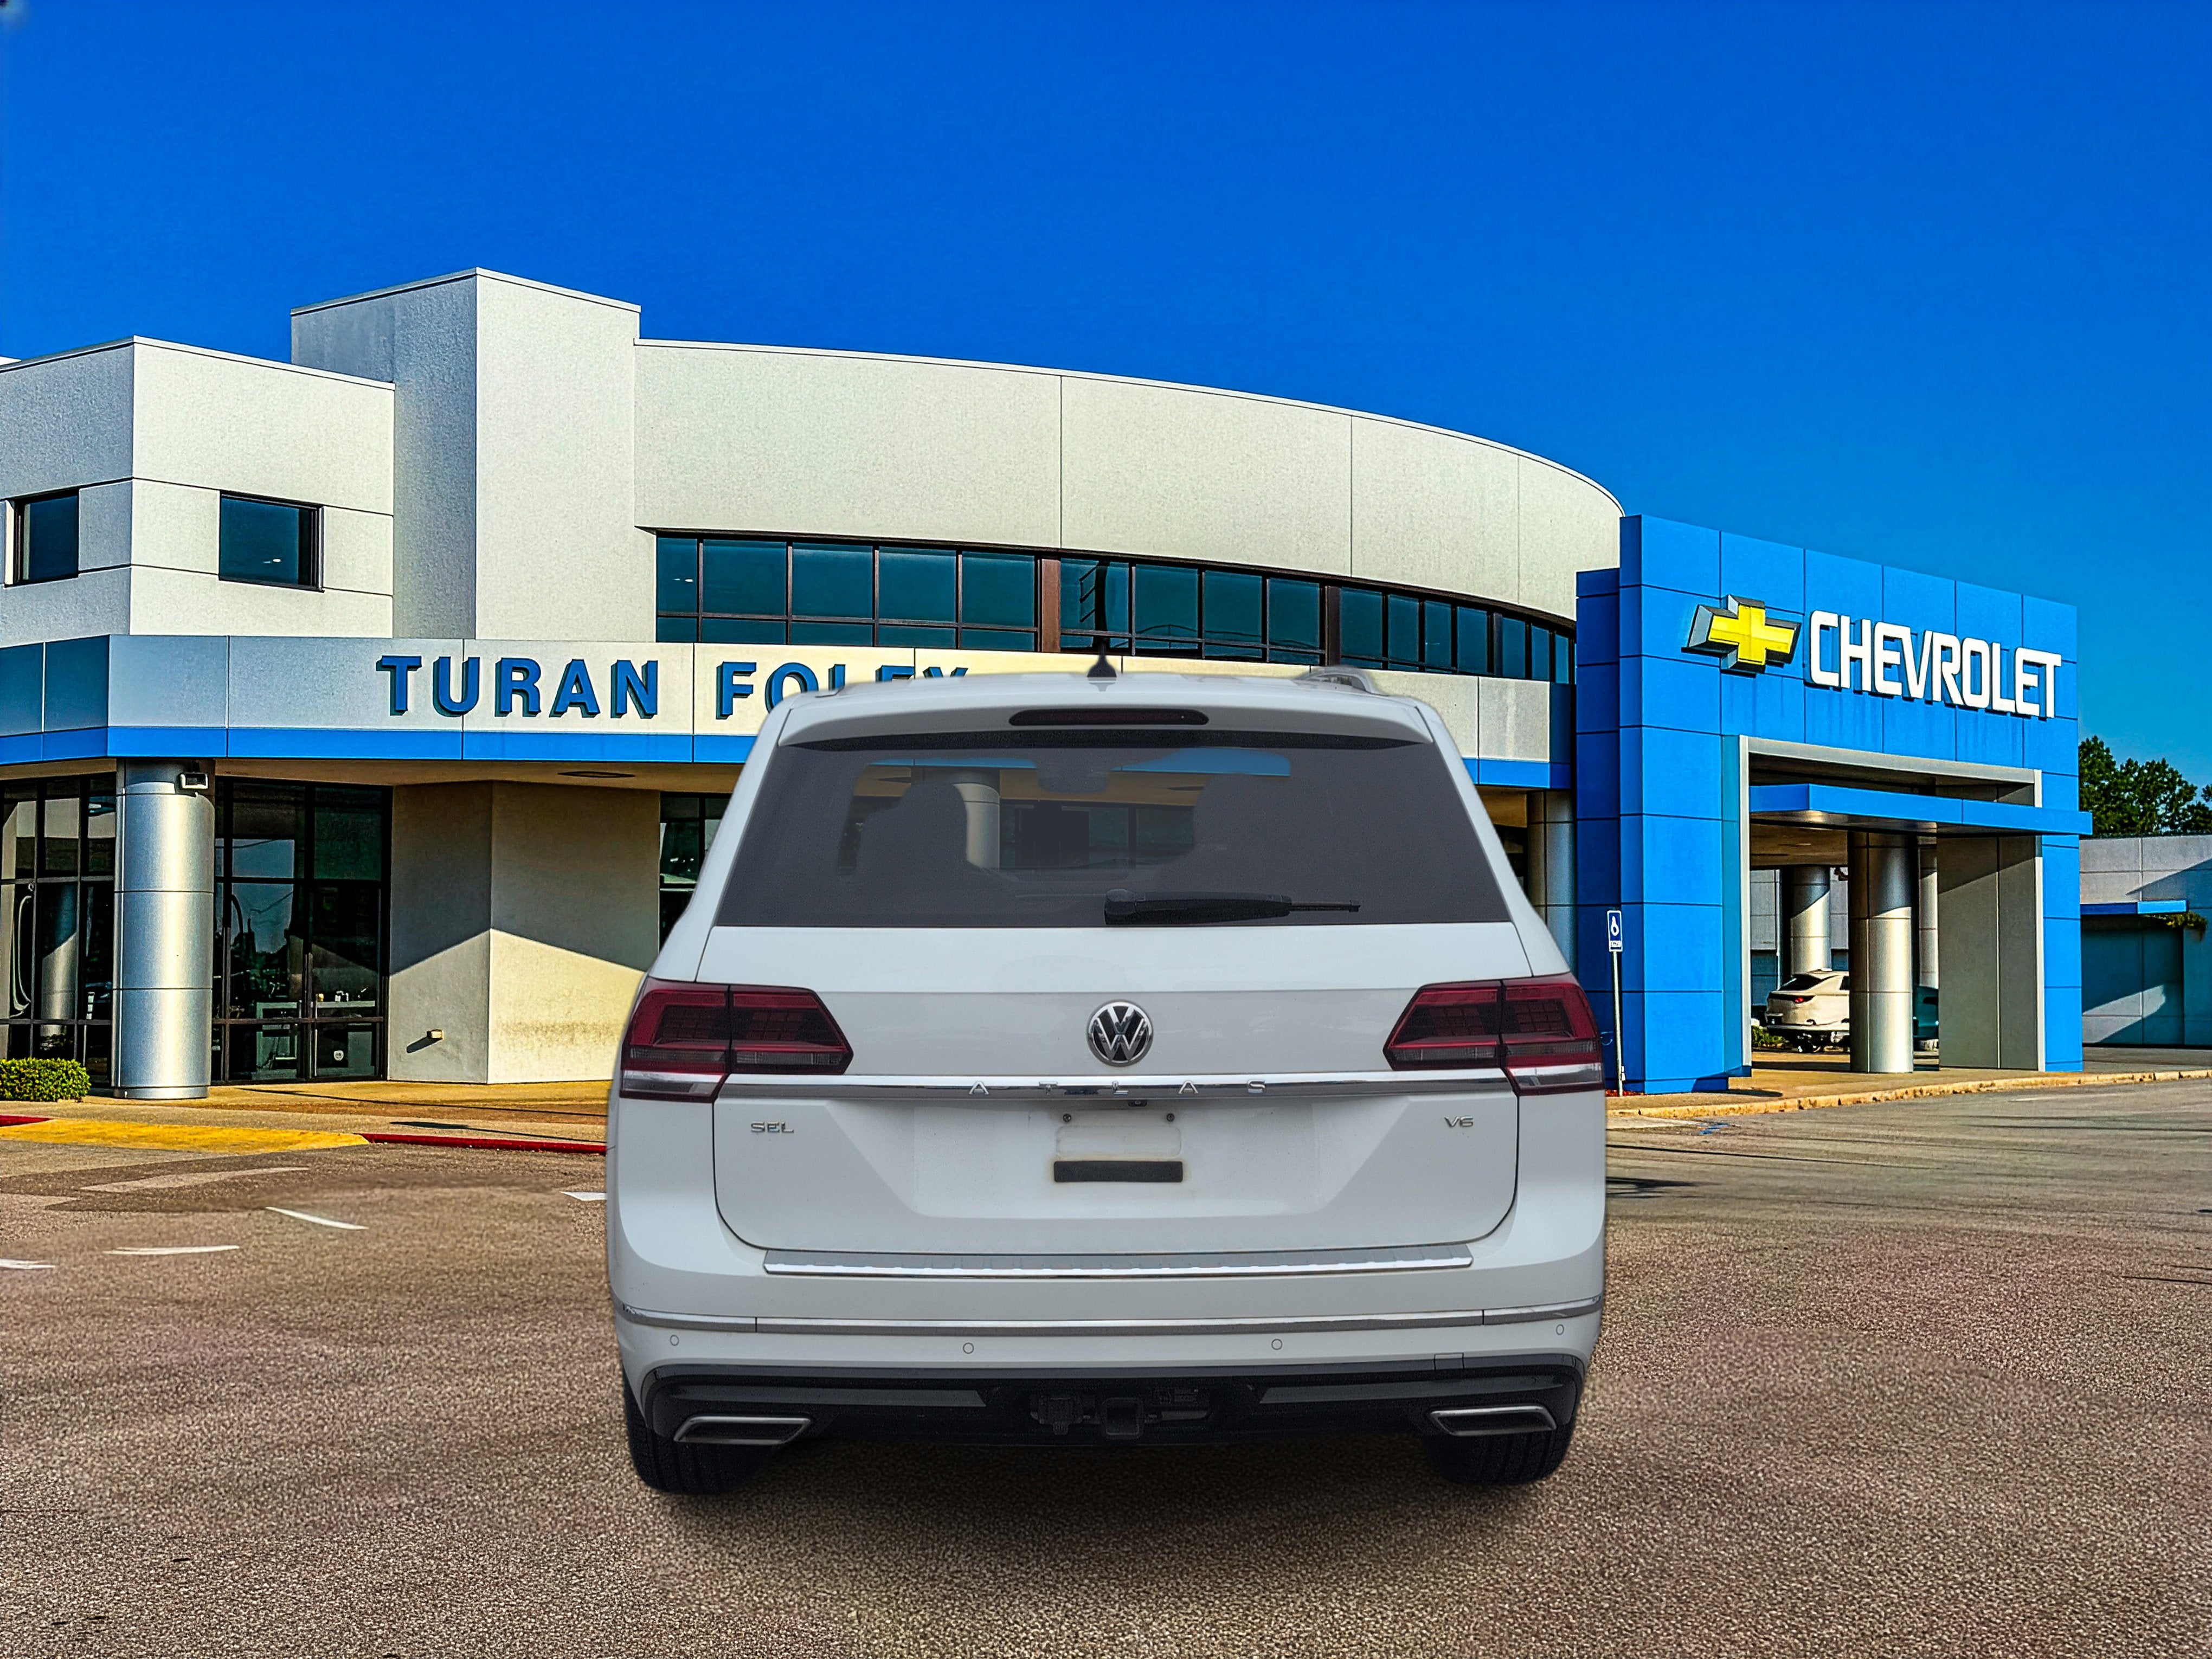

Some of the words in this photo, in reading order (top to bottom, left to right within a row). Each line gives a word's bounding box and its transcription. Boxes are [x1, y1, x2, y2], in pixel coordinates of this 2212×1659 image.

[1809, 610, 2062, 719] CHEVROLET
[376, 655, 659, 719] TURAN
[1090, 1002, 1150, 1064] VW
[969, 1079, 1267, 1095] ATLAS
[751, 1121, 794, 1133] SEL
[1444, 1116, 1474, 1128] V6
